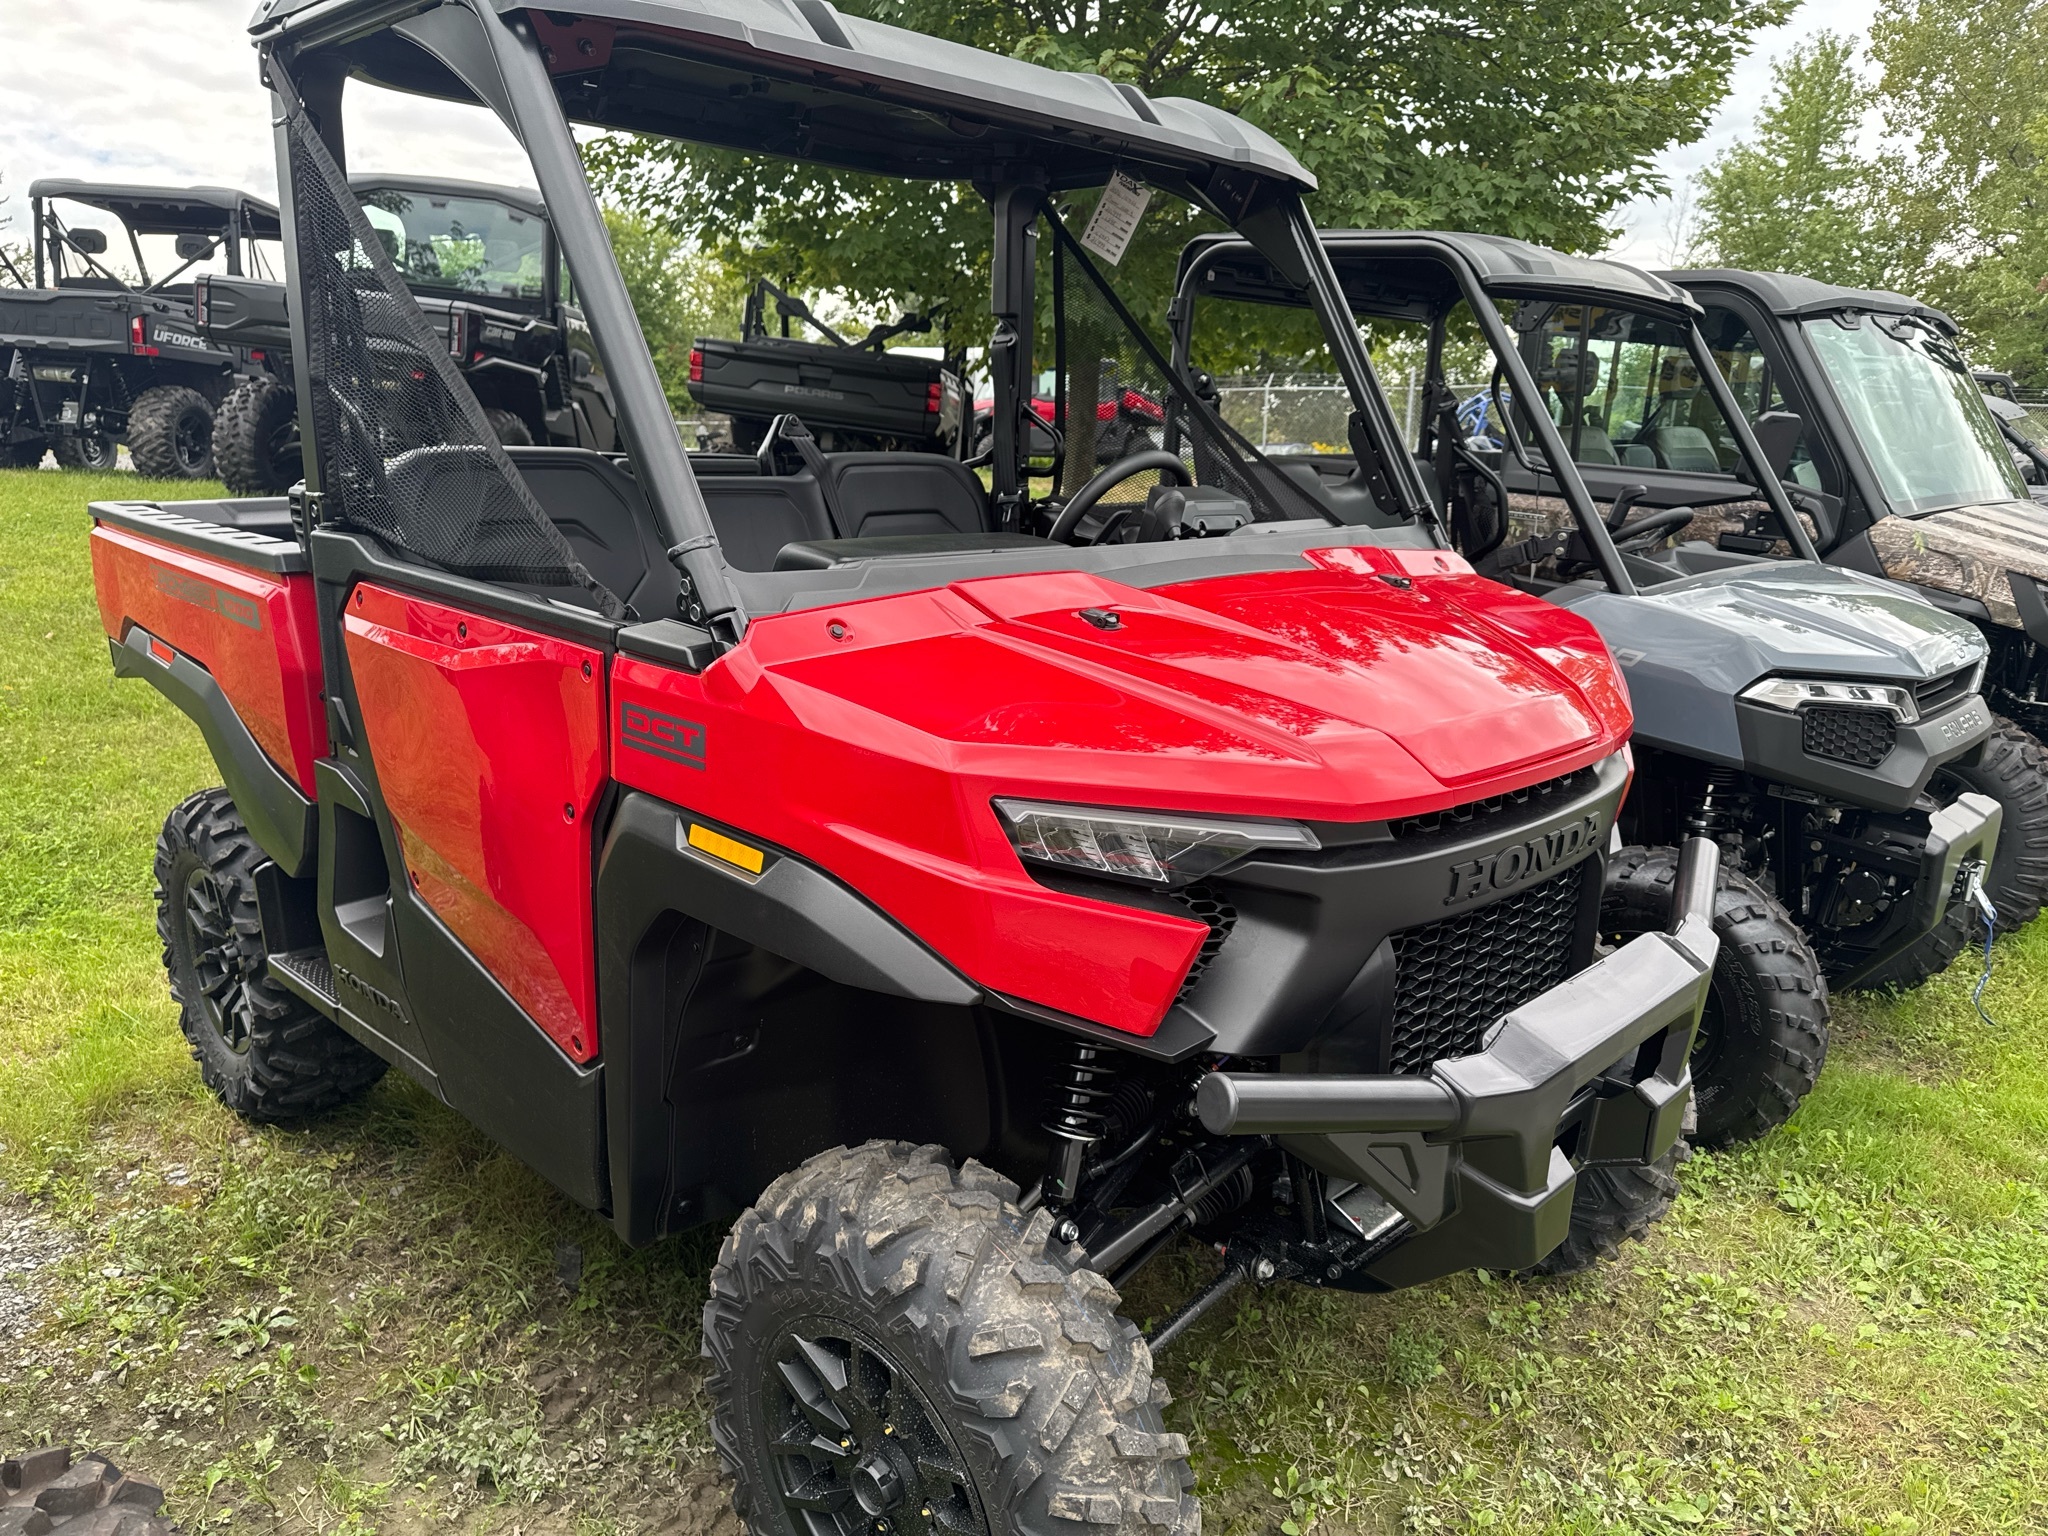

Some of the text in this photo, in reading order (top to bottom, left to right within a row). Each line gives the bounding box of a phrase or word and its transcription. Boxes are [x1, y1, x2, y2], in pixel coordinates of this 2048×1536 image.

[153, 329, 207, 350] UFORCE
[784, 384, 845, 401] POLARIS
[626, 709, 700, 748] DCT
[1940, 710, 1983, 741] POLARIS
[1443, 810, 1603, 906] HONDA
[334, 963, 409, 1025] HONDA
